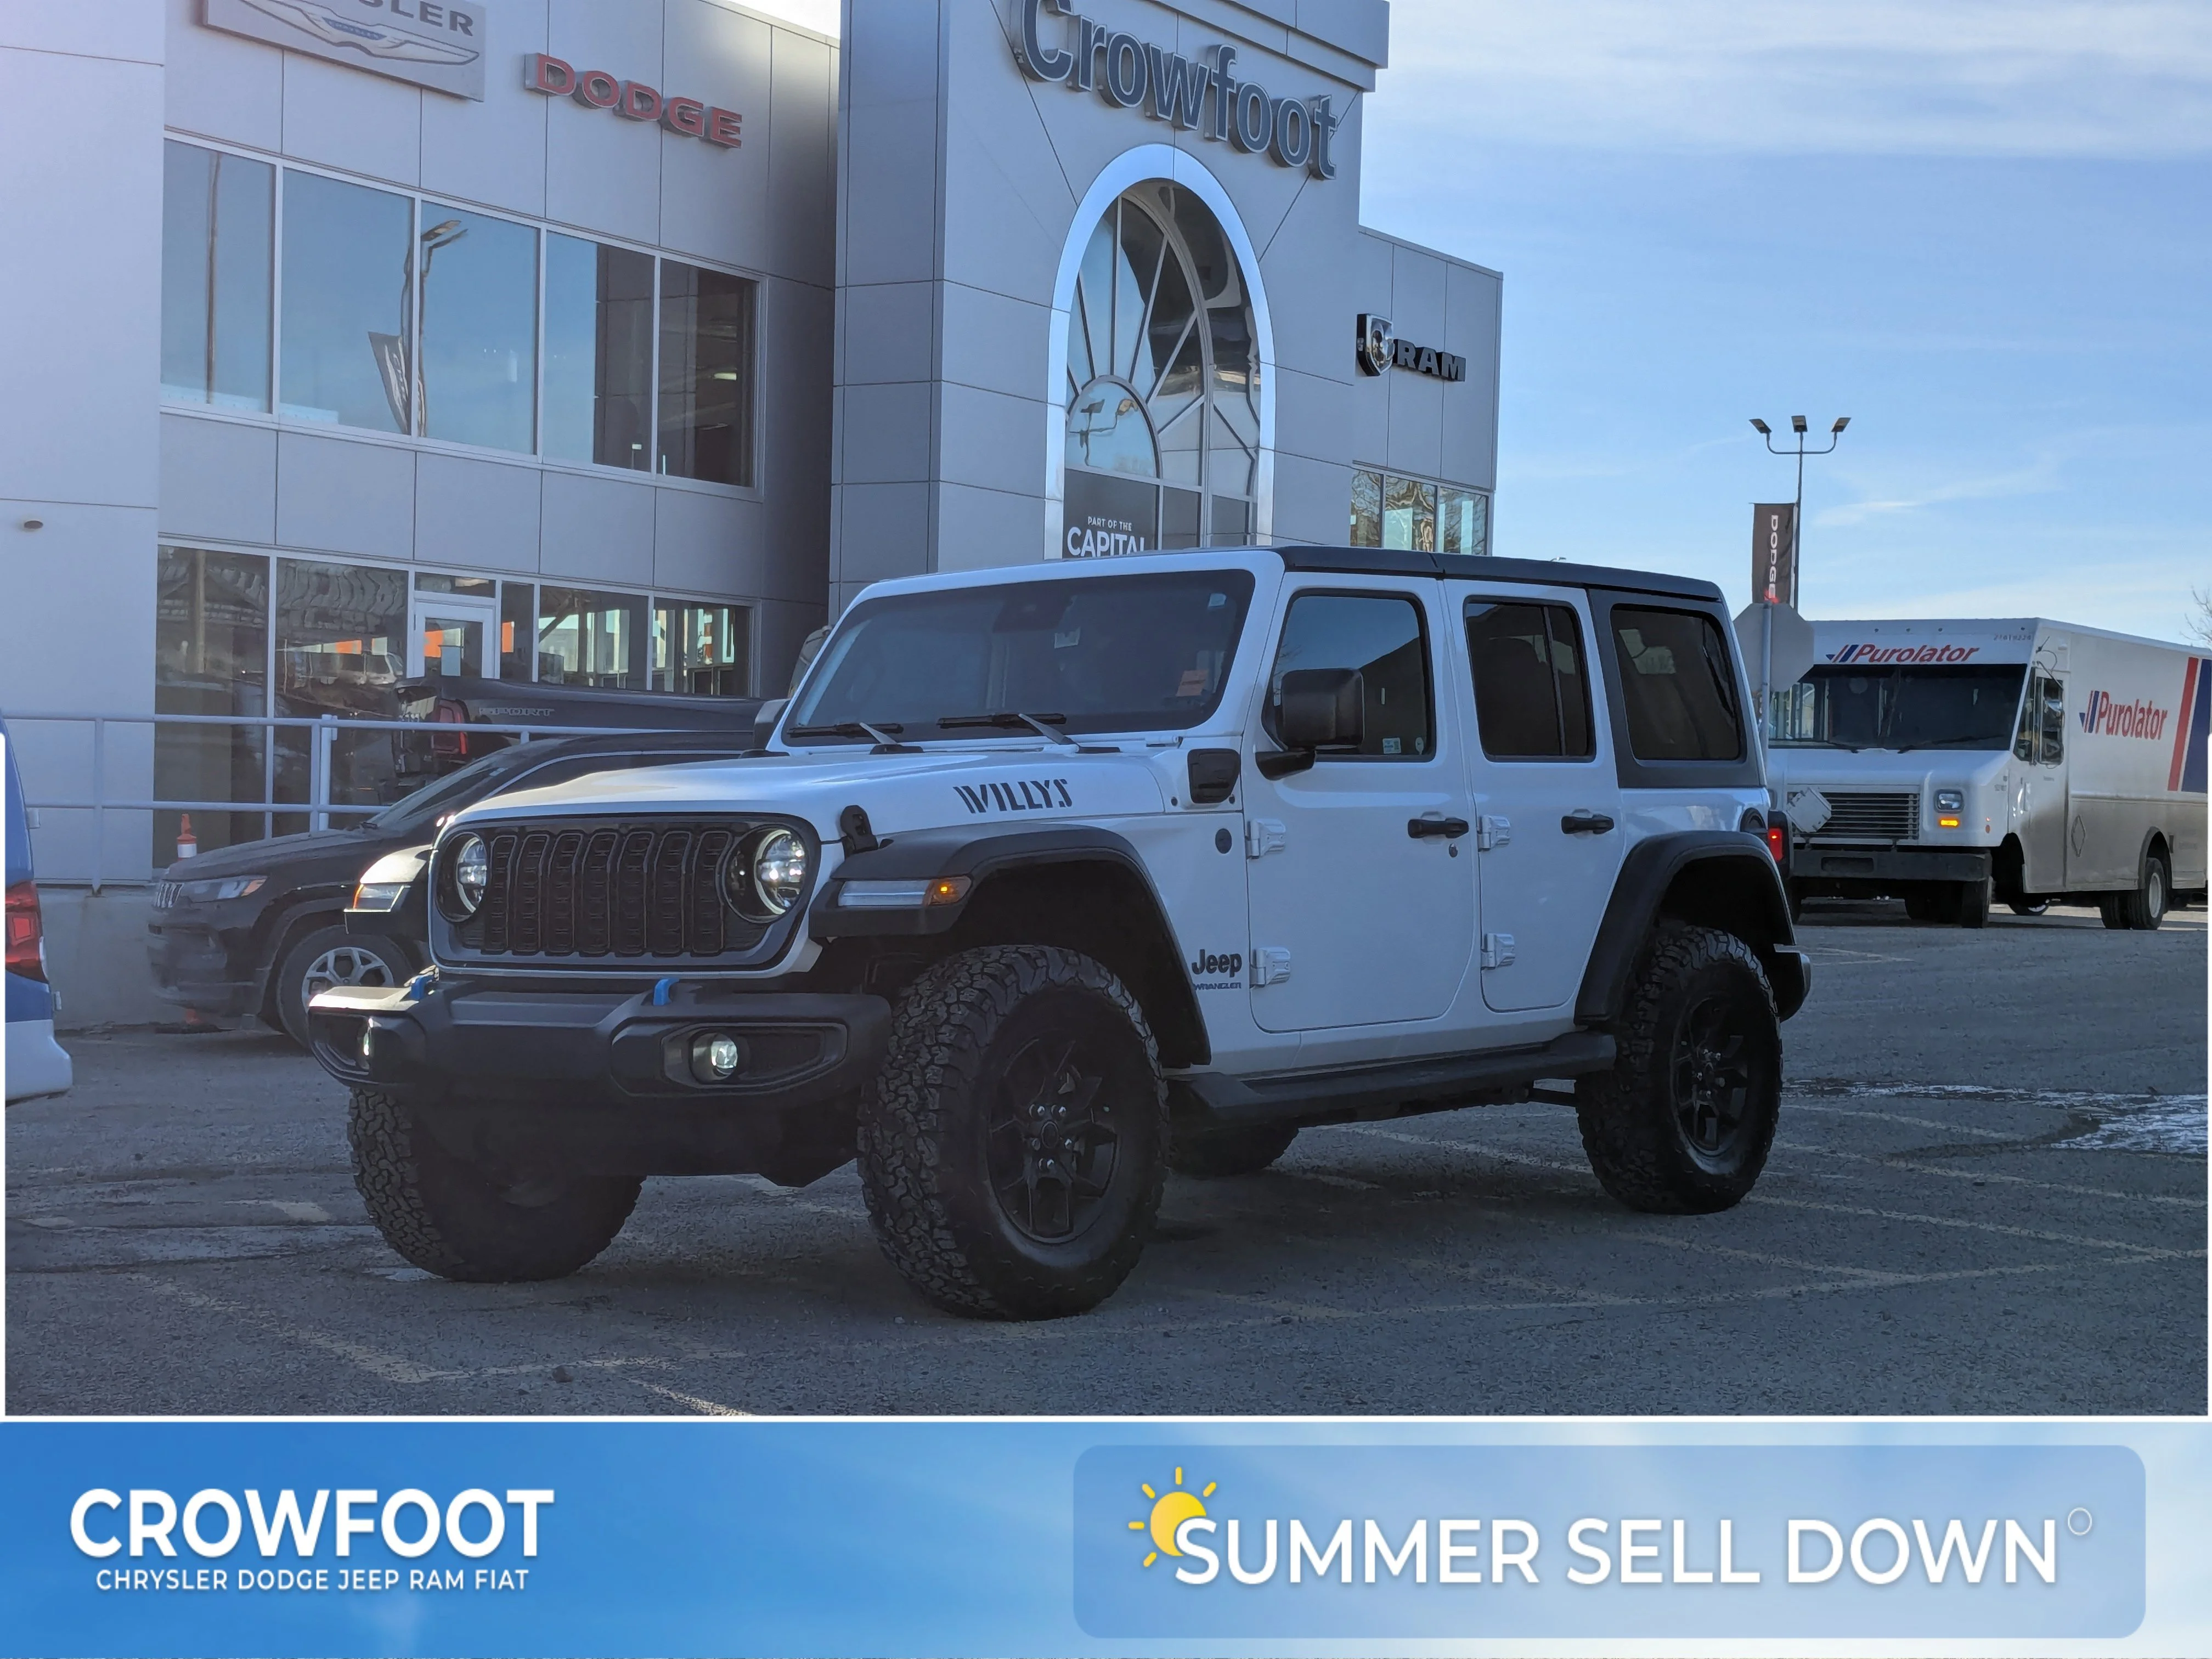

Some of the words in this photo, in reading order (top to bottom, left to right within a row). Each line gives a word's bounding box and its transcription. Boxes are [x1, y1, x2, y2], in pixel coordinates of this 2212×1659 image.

[532, 53, 743, 149] DODGE
[1020, 0, 1338, 180] Crowfoot
[1395, 338, 1466, 382] RAM
[1087, 516, 1106, 527] PART
[1108, 519, 1118, 529] OF
[1119, 521, 1132, 532] THE
[1851, 644, 1980, 663] Purolator
[2095, 691, 2168, 740] Purolator
[952, 778, 1073, 814] WILLYS
[1191, 949, 1243, 978] Jeep
